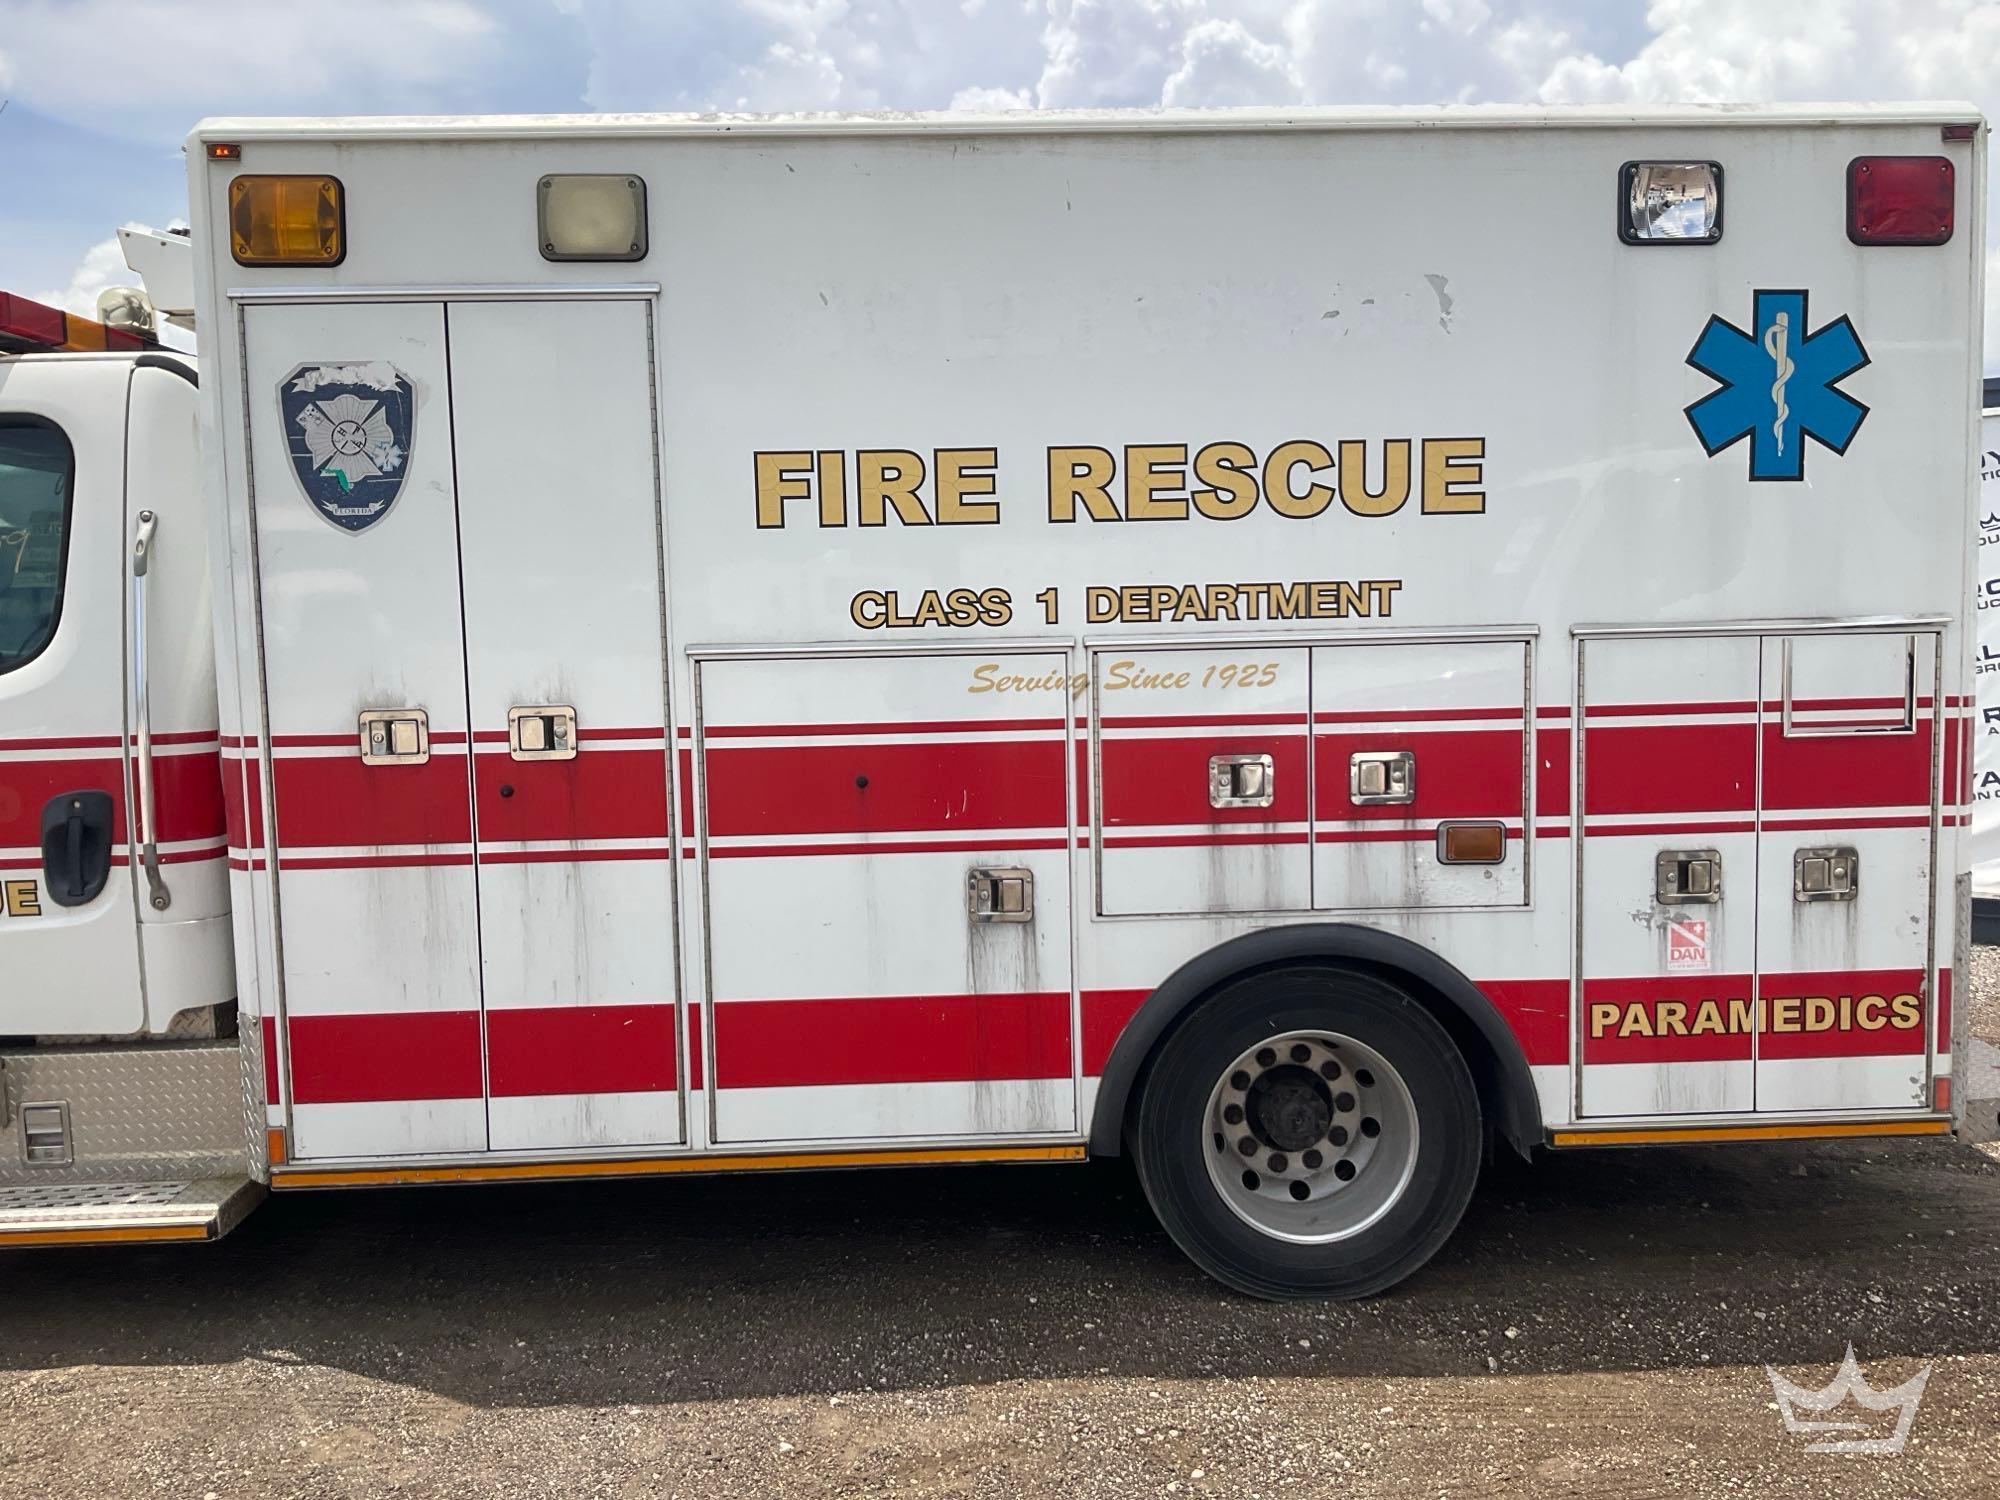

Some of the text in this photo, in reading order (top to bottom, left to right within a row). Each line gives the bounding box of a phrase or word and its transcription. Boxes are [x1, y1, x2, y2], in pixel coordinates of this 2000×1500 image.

[754, 437, 1487, 529] FIRE RESCUE
[334, 507, 373, 515] FLORIDA
[851, 579, 1403, 629] CLASS 1 DEPARTMENT
[968, 660, 1280, 701] Serving Since 1925
[0, 880, 41, 917] E
[1671, 948, 1706, 961] DAN
[1590, 994, 1921, 1039] PARAMEDICS
